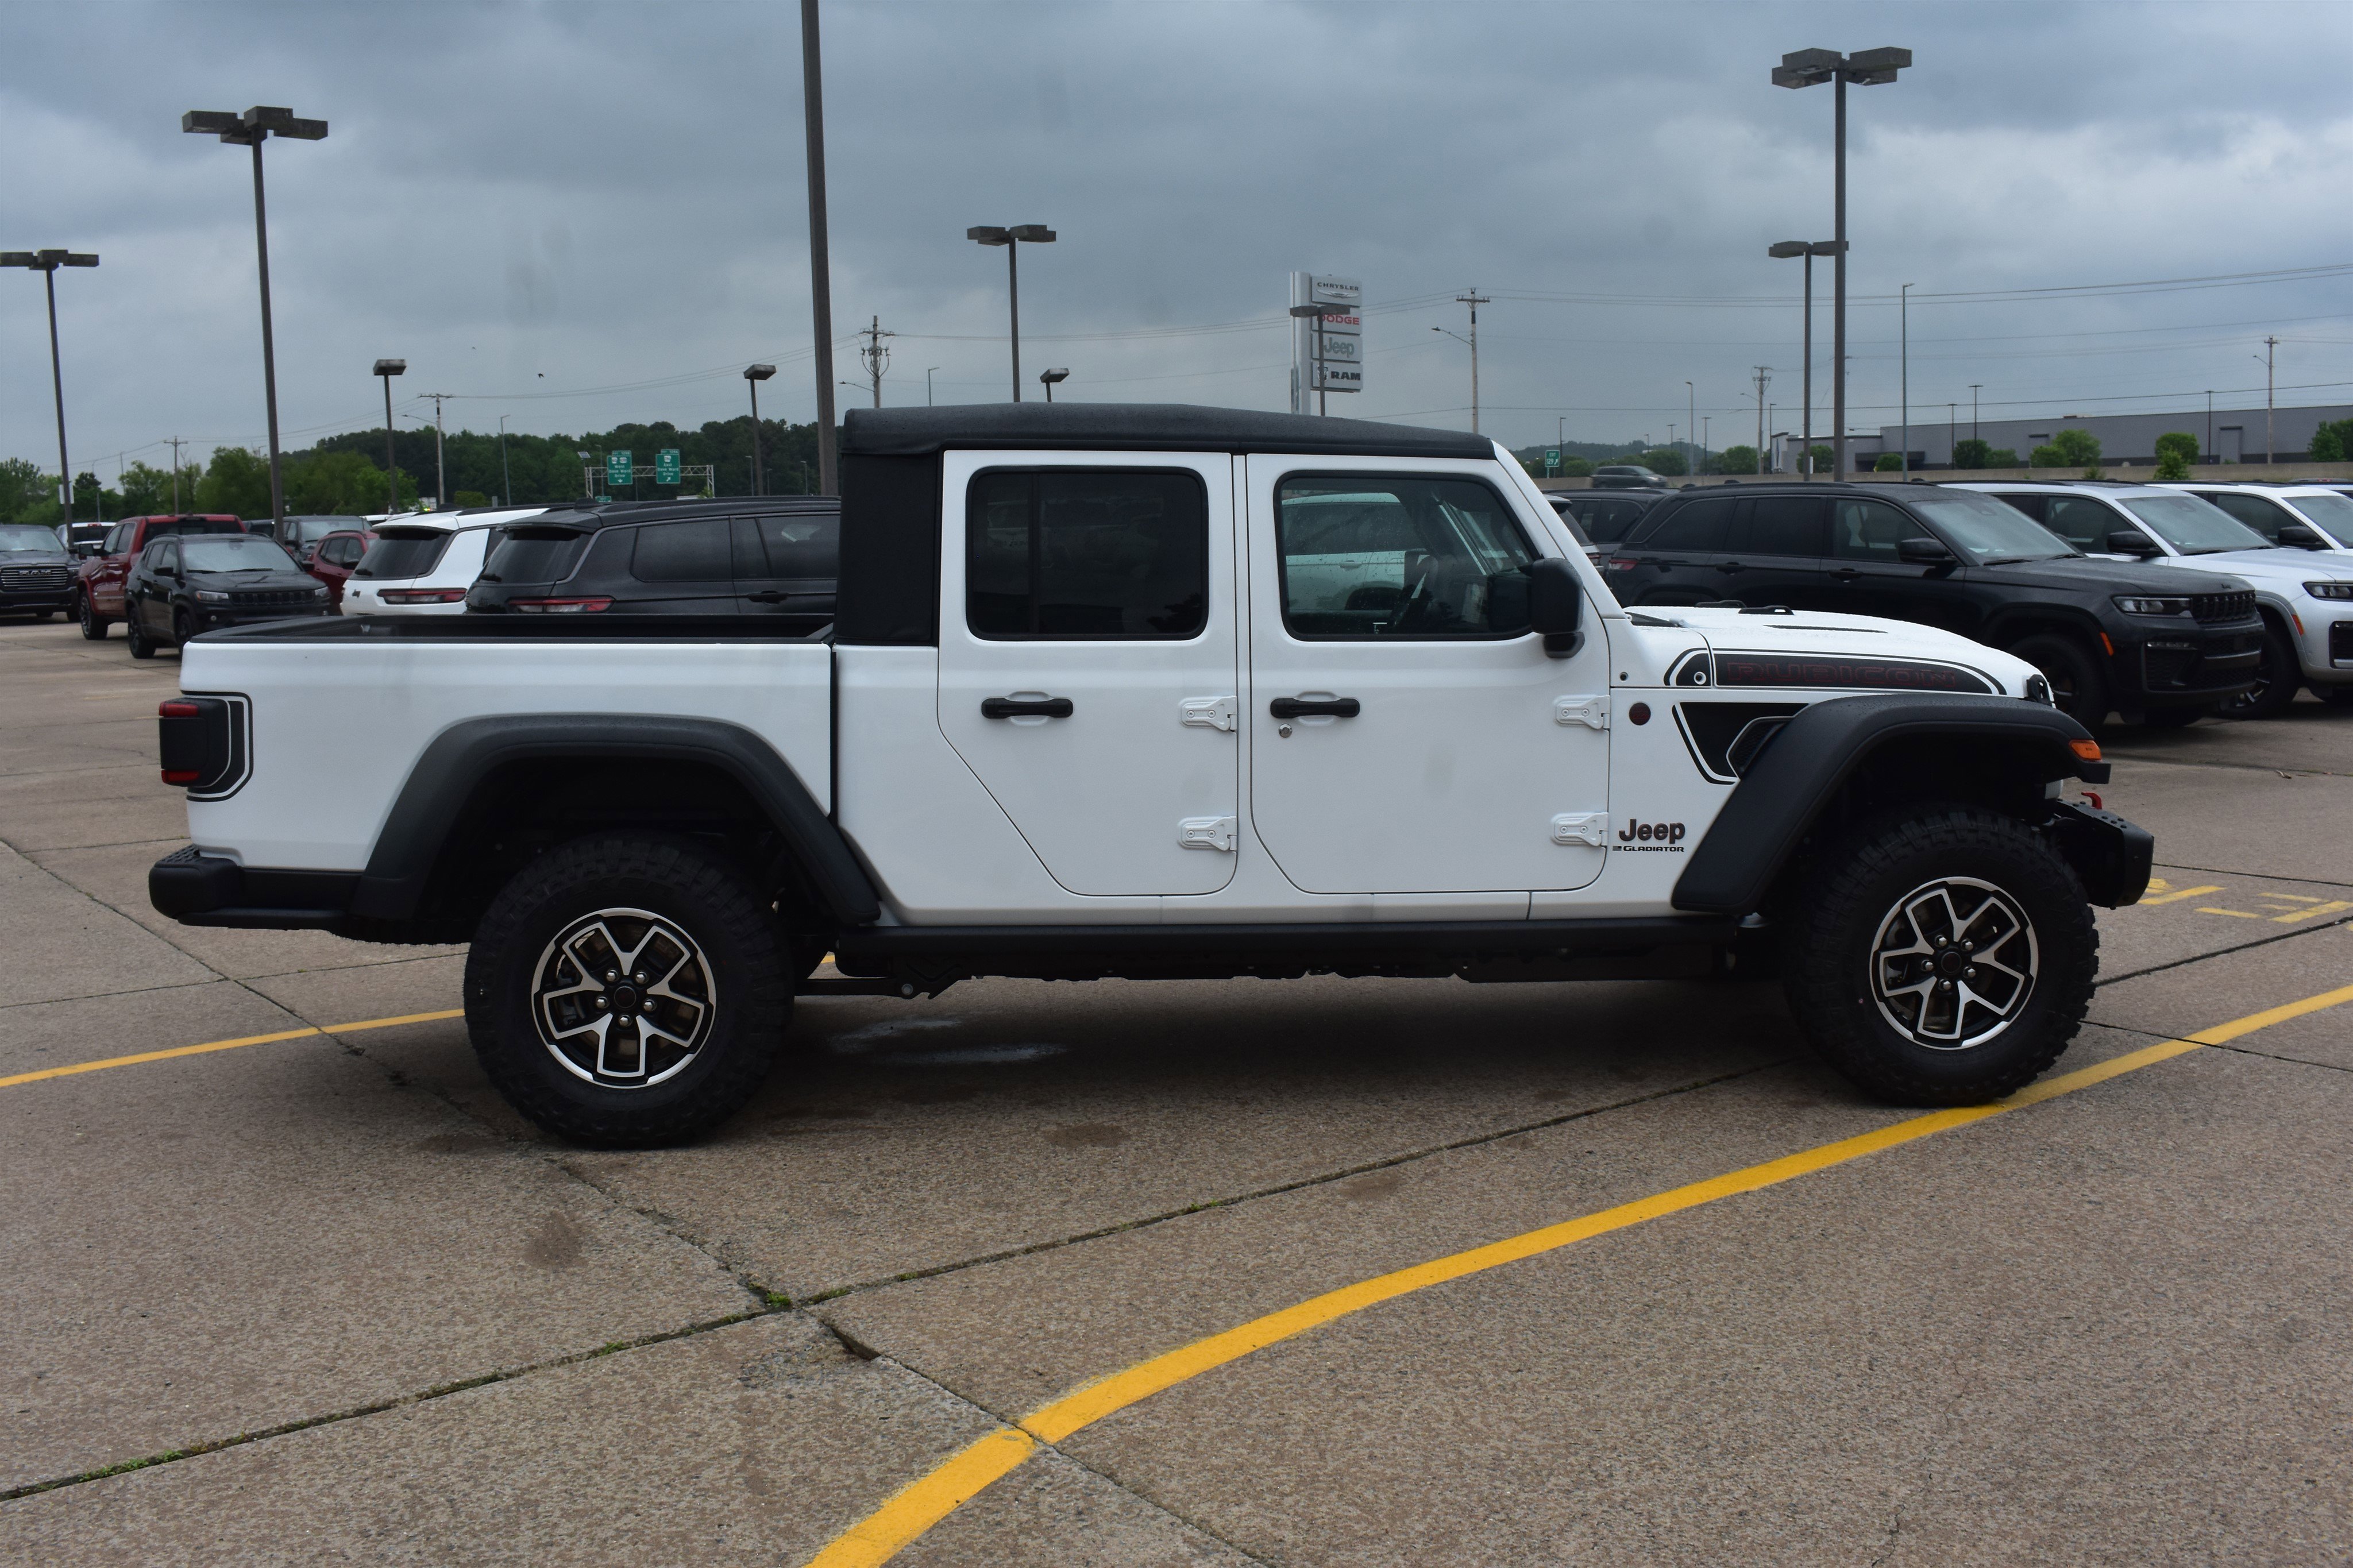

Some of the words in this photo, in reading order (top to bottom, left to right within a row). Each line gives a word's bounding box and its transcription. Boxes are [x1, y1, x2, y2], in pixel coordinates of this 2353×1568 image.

[1317, 282, 1359, 291] CHRYSLER
[1324, 337, 1355, 358] Jeep
[1331, 370, 1361, 381] RAM
[1727, 662, 1954, 688] RUBICON
[1619, 818, 1685, 844] Jeep
